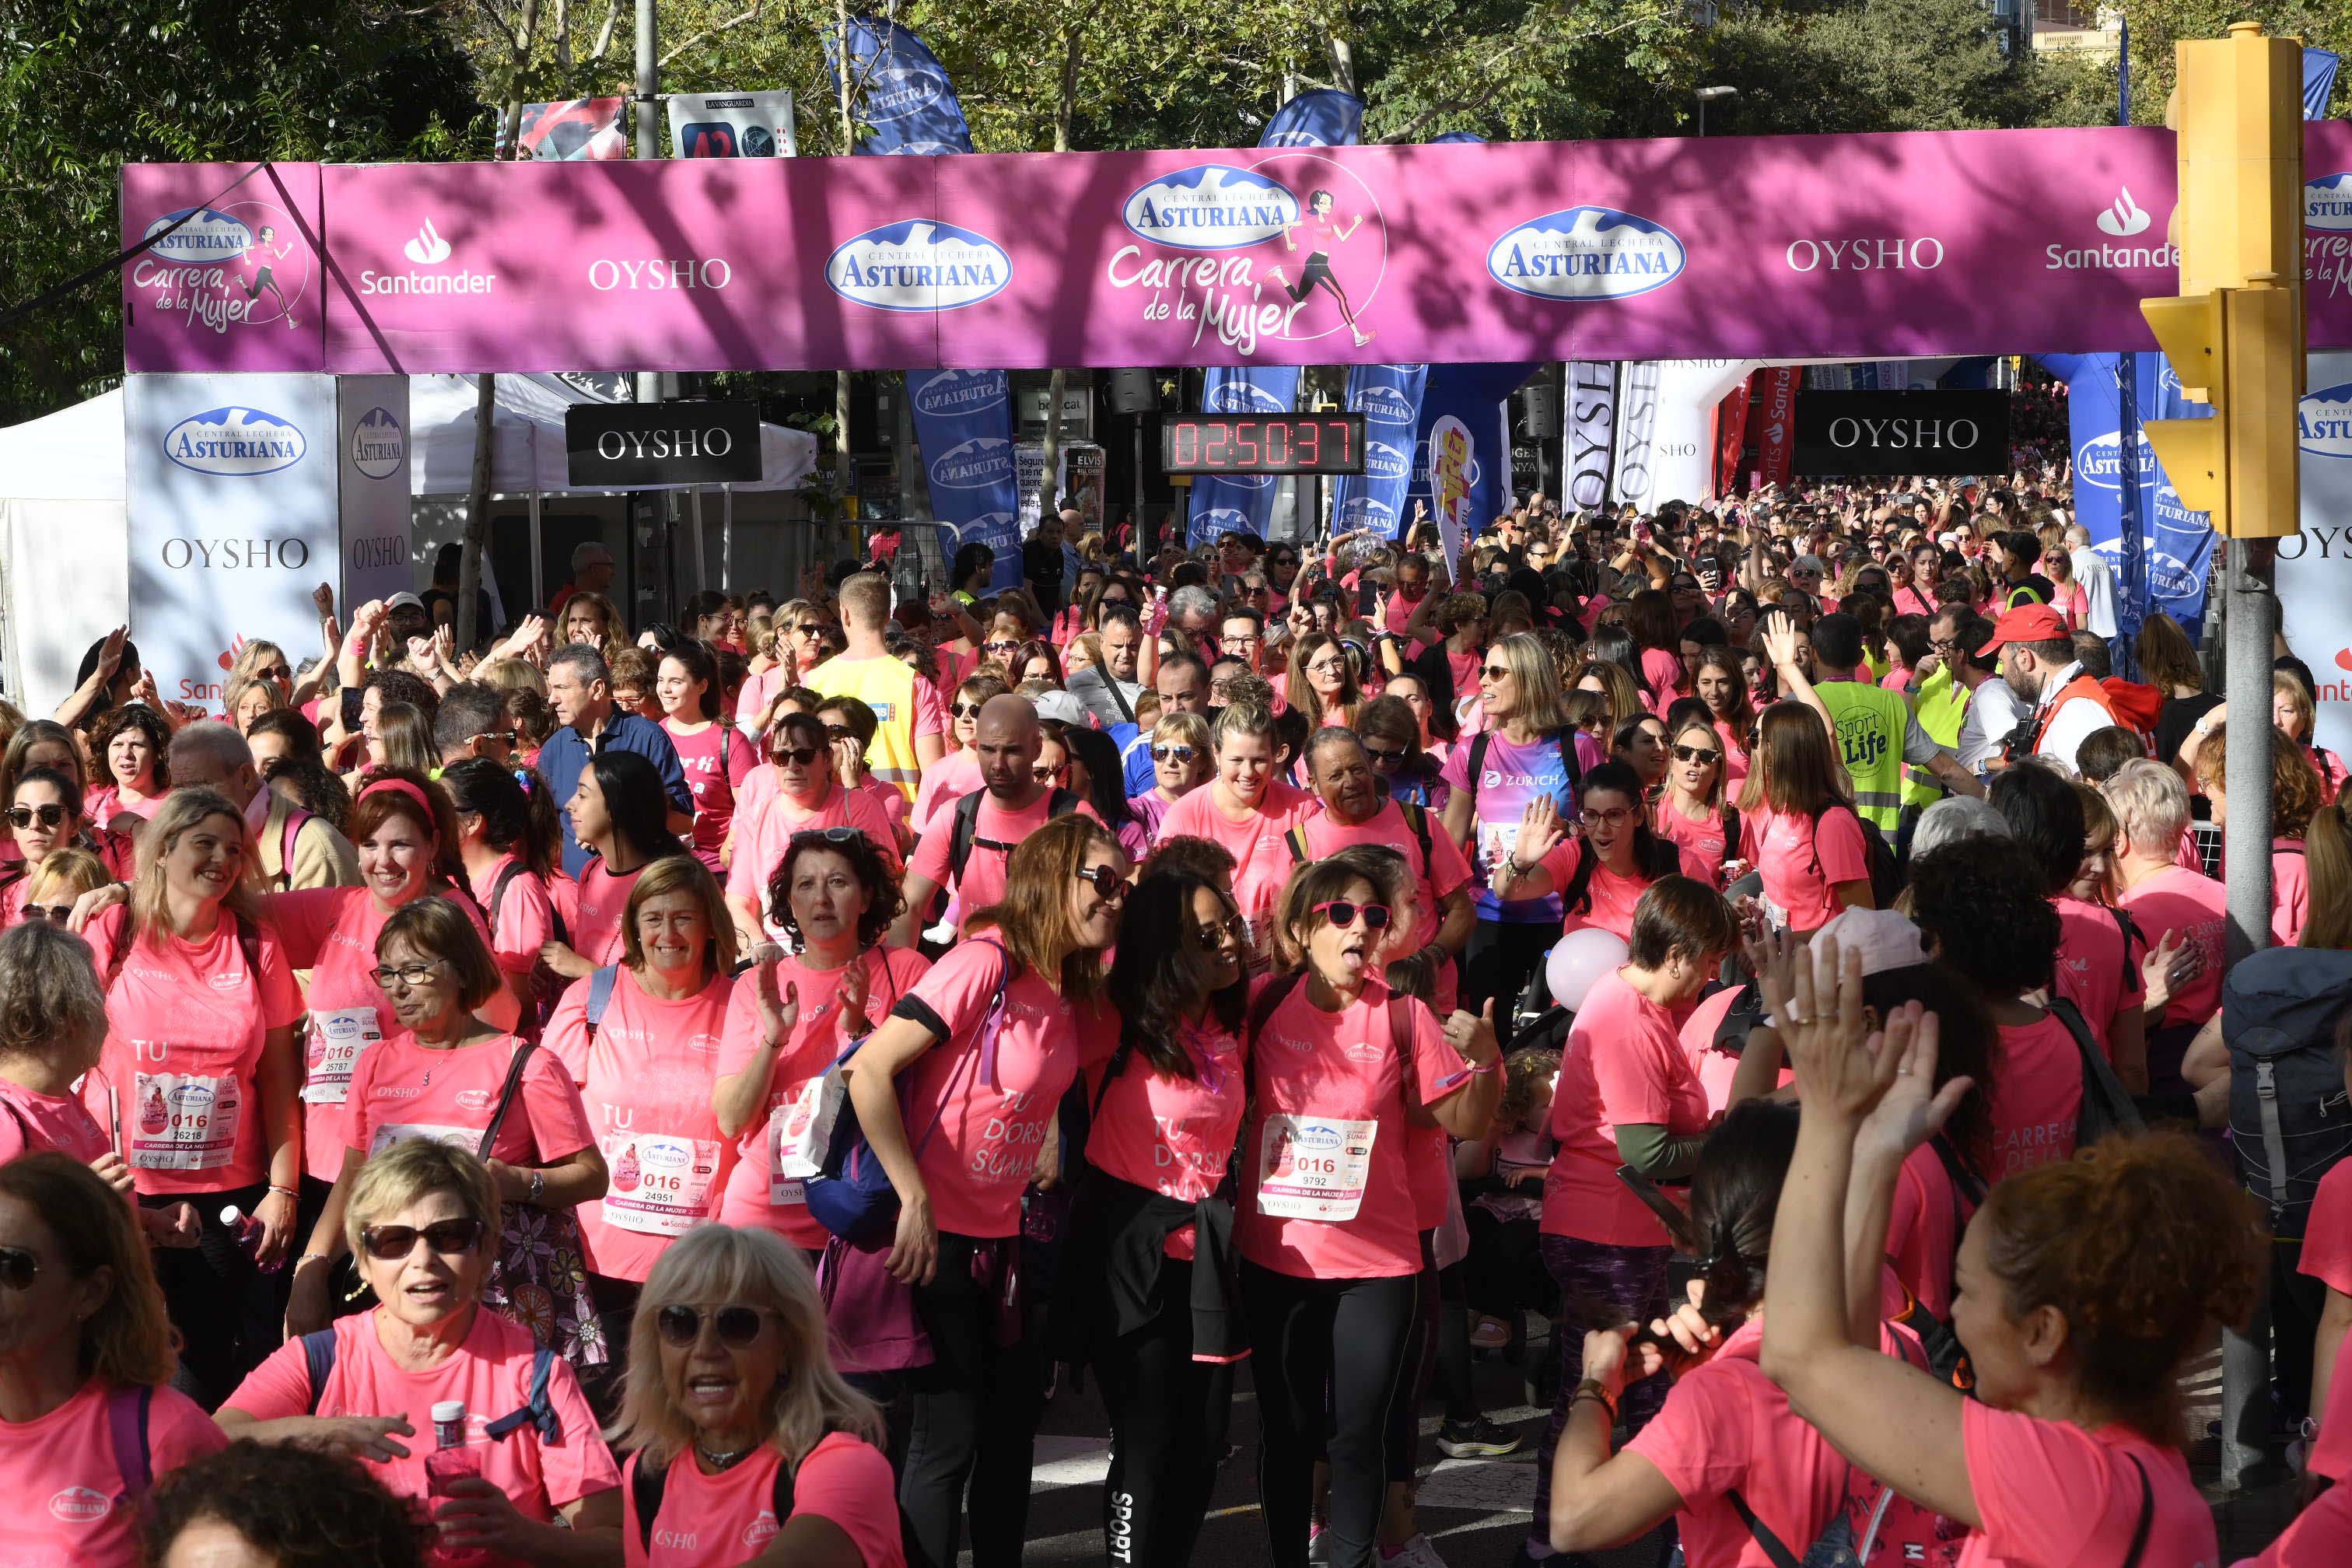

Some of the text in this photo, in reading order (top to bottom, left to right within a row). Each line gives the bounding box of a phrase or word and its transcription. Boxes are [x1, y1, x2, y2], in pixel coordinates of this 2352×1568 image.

[715, 98, 754, 108] VANGUARDIA
[1164, 193, 1281, 203] CENTRAL LECHERA
[1136, 197, 1286, 228] ASTURIANA
[1533, 236, 1664, 249] CENTRAL LECHERA
[1786, 236, 1944, 272] OYSHO
[869, 250, 992, 261] CENTRAL LECHERA
[1108, 245, 1254, 288] Carrera
[1503, 243, 1671, 278] ASTURIANA
[2046, 241, 2179, 269] Santande
[133, 259, 225, 288] Carrera
[588, 257, 732, 291] OYSHO
[841, 253, 997, 288] ASTURIANA
[2319, 259, 2333, 281] la
[361, 269, 495, 295] Santander
[156, 289, 189, 310] de la
[187, 285, 260, 334] Mujer
[1143, 289, 1195, 320] de la
[1192, 283, 1307, 355] Mujer
[1770, 366, 1790, 419] Santa
[1572, 362, 1612, 511] OYSH
[1620, 362, 1659, 500] OYSH
[1829, 417, 1979, 450] OYSHO
[175, 432, 297, 459] ASTURIANA
[355, 434, 401, 461] ASTURIANA
[597, 427, 732, 460] OYSHO
[1175, 422, 1349, 464] 02:50:37
[1659, 443, 1696, 457] SHO
[1077, 456, 1101, 465] ELVIS
[1019, 468, 1032, 477] que
[1020, 477, 1045, 487] quiere
[1020, 499, 1035, 507] este
[2157, 503, 2210, 529] TURIANA
[162, 537, 309, 570] OYSHO
[353, 534, 405, 570] OYSHO
[1835, 712, 1879, 741] Sport
[1845, 730, 1887, 765] Life
[1506, 774, 1559, 787] ZURICH
[131, 1039, 169, 1062] TU
[327, 1045, 355, 1060] 016
[1269, 1031, 1313, 1053] OYSHO
[325, 1062, 348, 1072] 25787
[171, 1092, 212, 1103] ASTURIANA
[377, 1086, 420, 1098] OYSHO
[1000, 1087, 1034, 1112] TU
[171, 1114, 208, 1128] 016
[602, 1102, 633, 1129] TU
[173, 1131, 201, 1140] 26218
[982, 1118, 1048, 1144] DORSA
[1153, 1115, 1186, 1141] TU
[1297, 1133, 1339, 1145] ASTURIANA
[139, 1154, 173, 1164] OYSHO
[646, 1150, 686, 1164] ASTURIANA
[971, 1149, 1034, 1175] SUMA
[1298, 1157, 1335, 1173] 016
[2005, 1148, 2034, 1170] DE
[643, 1173, 681, 1190] 016
[1303, 1176, 1327, 1186] 9792
[614, 1199, 645, 1209] CARRERA
[645, 1192, 674, 1203] 24951
[1268, 1200, 1301, 1210] OYSHO
[611, 1211, 643, 1225] OYSHO
[51, 1499, 107, 1514] ASTURIANA
[1109, 1492, 1133, 1563] SPORT
